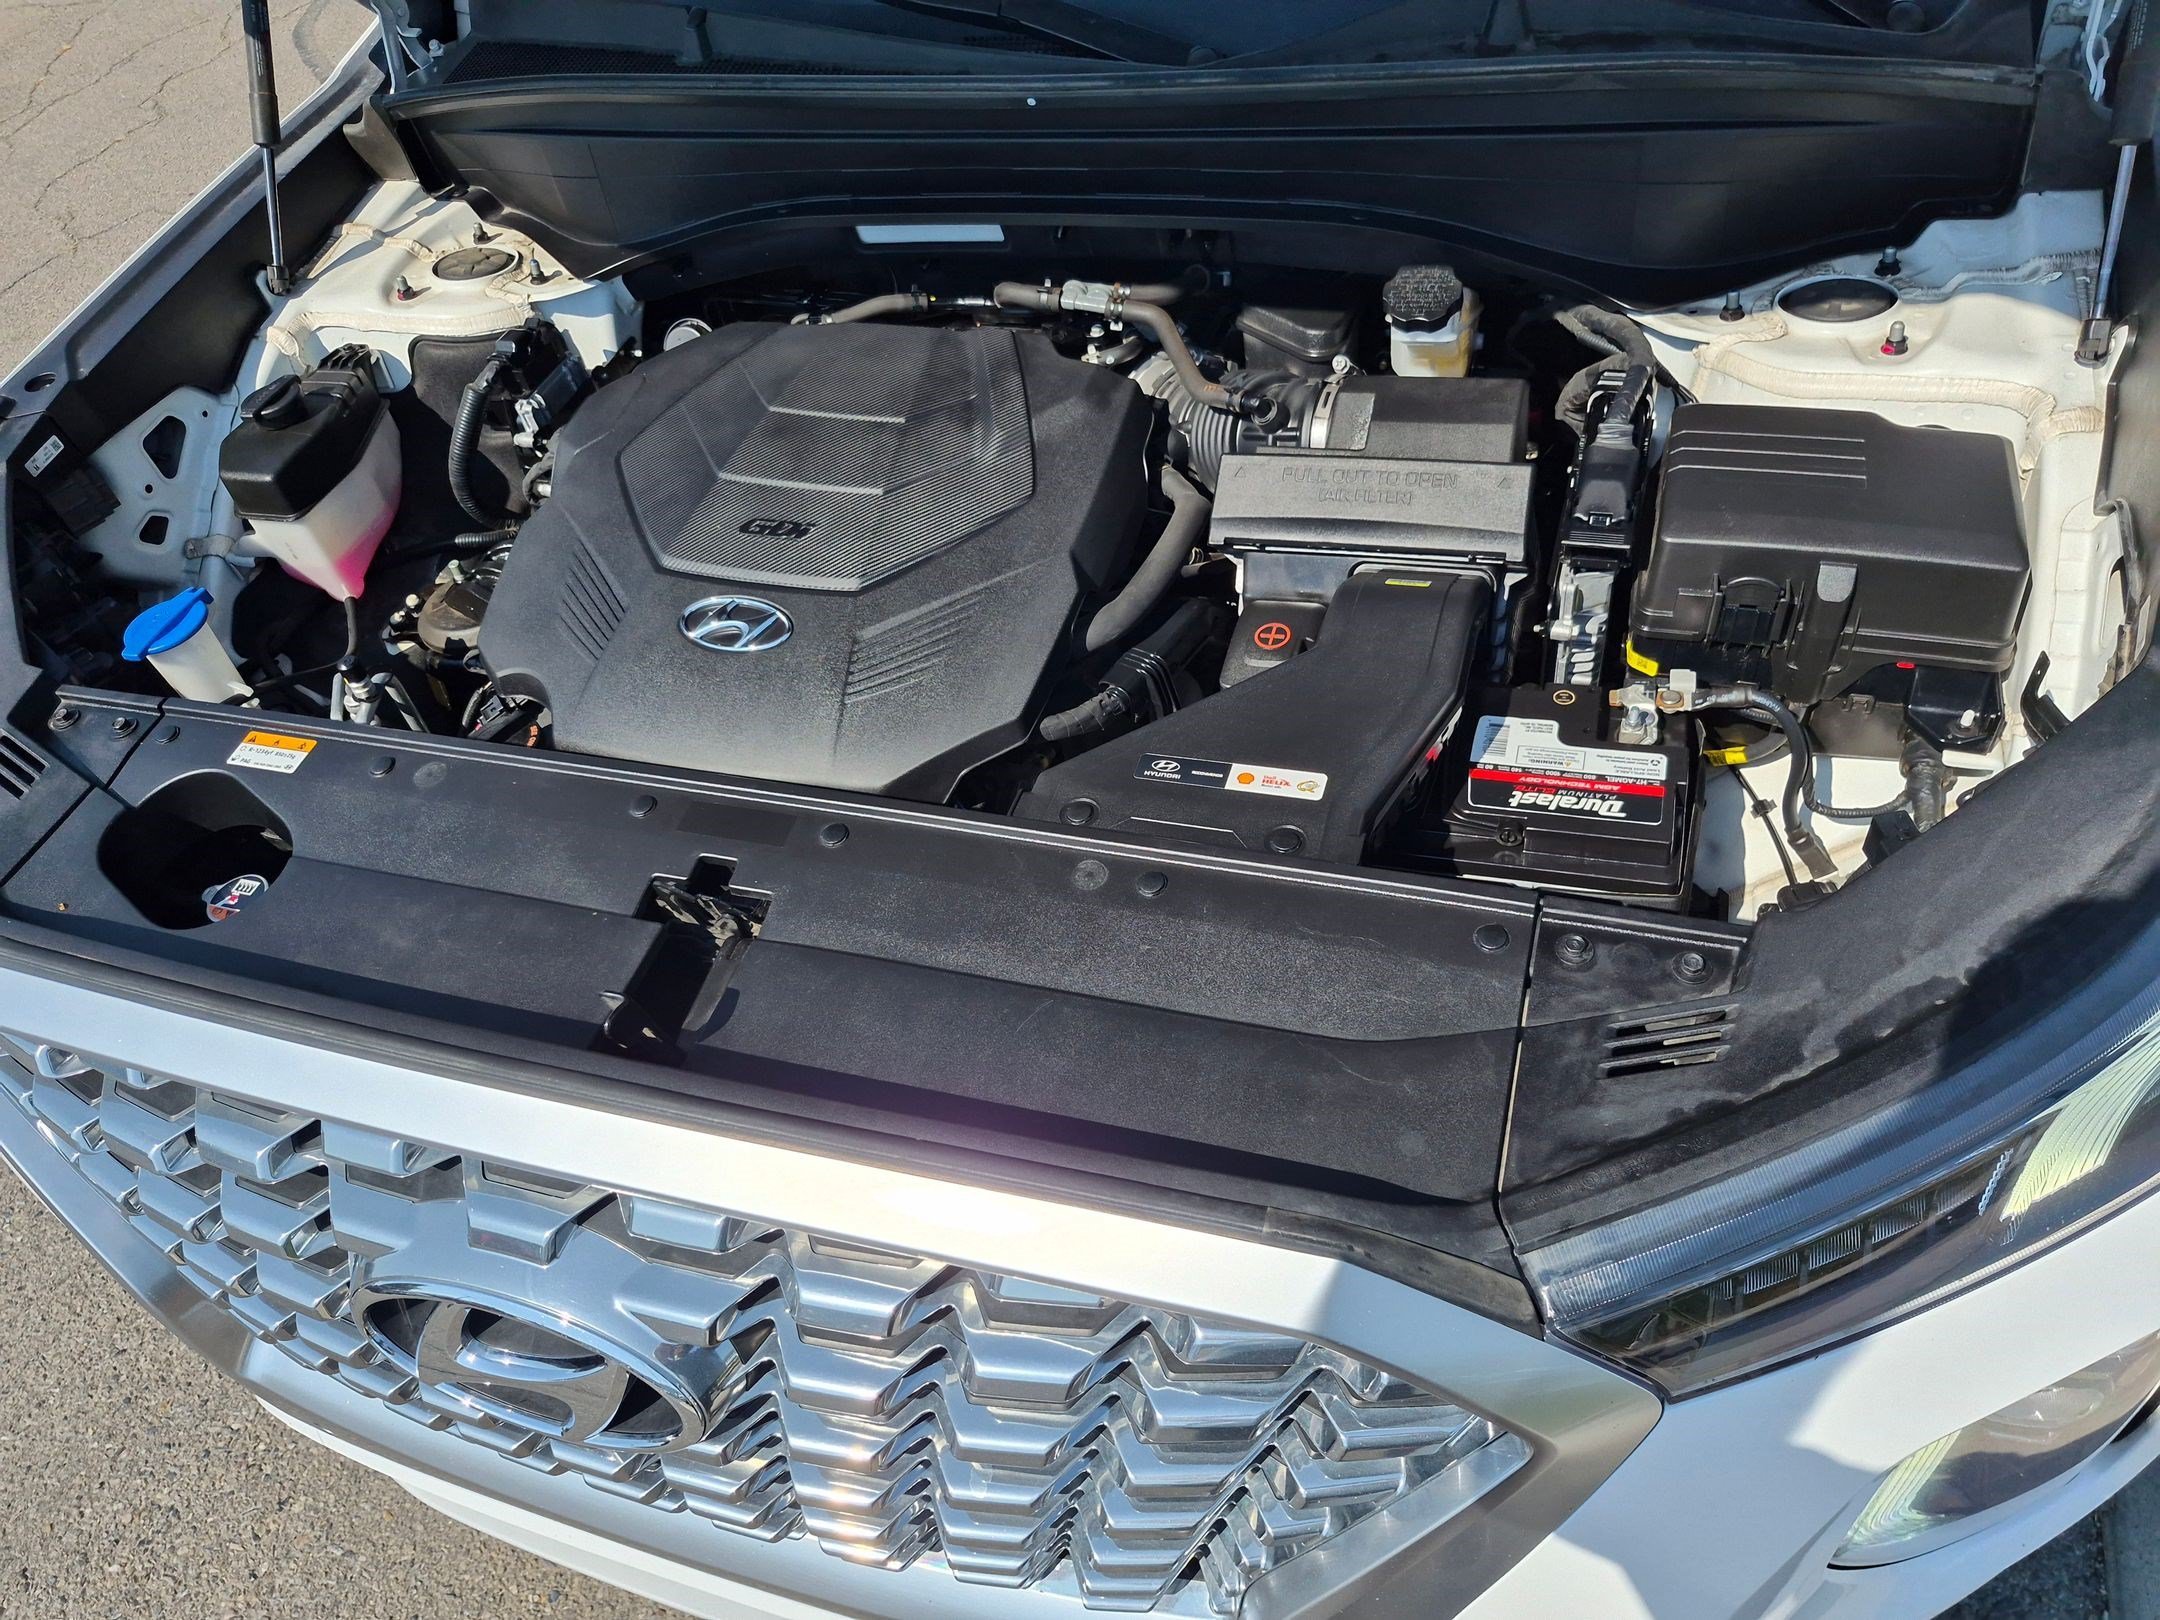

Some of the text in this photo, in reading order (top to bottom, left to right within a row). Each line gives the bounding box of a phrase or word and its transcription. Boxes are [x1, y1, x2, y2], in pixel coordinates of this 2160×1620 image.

[1282, 467, 1459, 489] PULL OUT TO OPEN
[1144, 770, 1182, 780] HYUNDAI
[1261, 778, 1291, 787] HELIX
[1519, 777, 1591, 788] TECHNOLOGY
[1558, 789, 1617, 800] PLATINUM
[1507, 790, 1627, 818] Duralast
